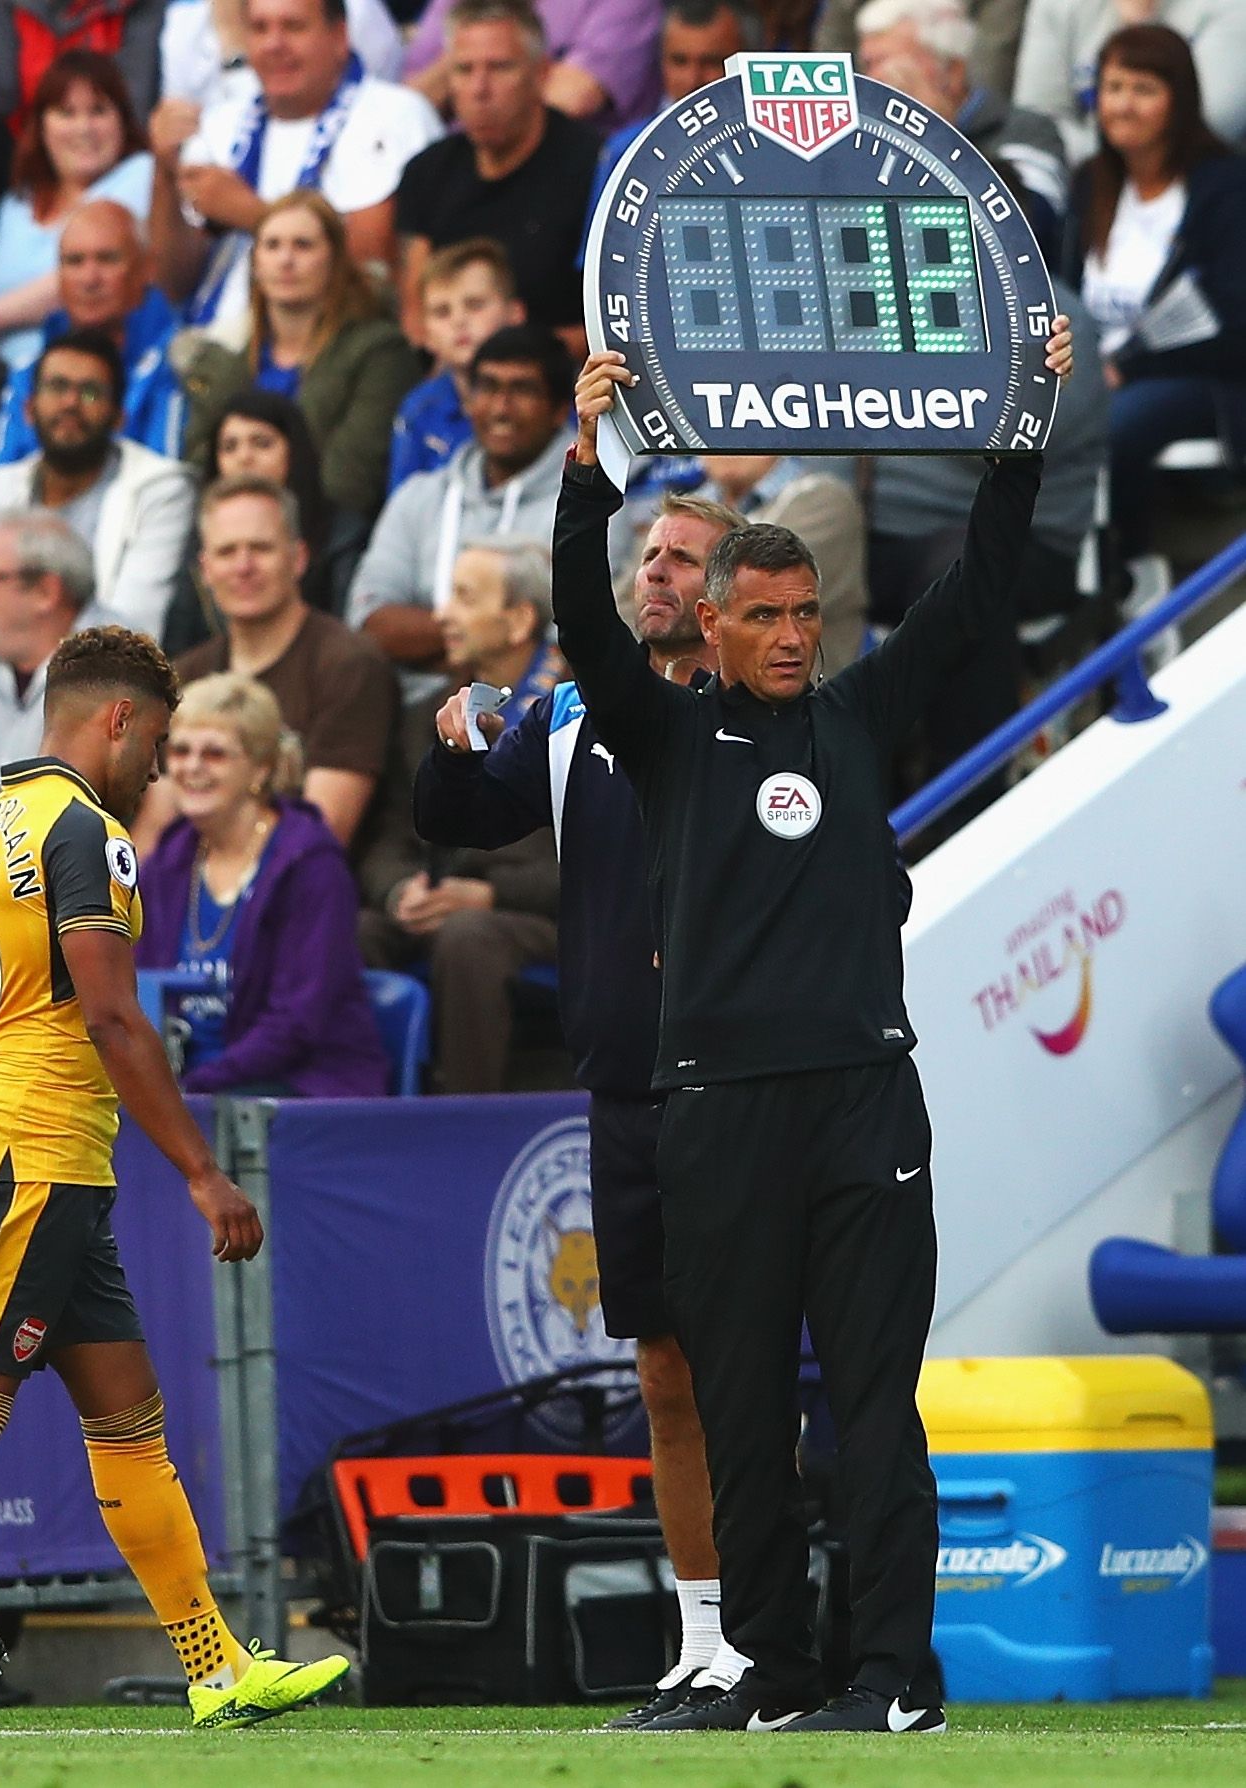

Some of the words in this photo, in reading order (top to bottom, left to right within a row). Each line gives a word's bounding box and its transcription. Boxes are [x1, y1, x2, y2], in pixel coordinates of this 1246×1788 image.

[752, 64, 844, 94] TAG
[677, 98, 719, 137] 55
[754, 100, 850, 153] HEUER
[885, 98, 929, 137] 05
[616, 178, 649, 226] 50
[979, 183, 1012, 223] 10
[607, 294, 631, 343] 45
[1026, 302, 1051, 337] 15
[767, 810, 813, 821] SPORTS
[768, 786, 811, 809] EA
[935, 1540, 1041, 1574] cozade
[1098, 1542, 1192, 1576] Lucozade
